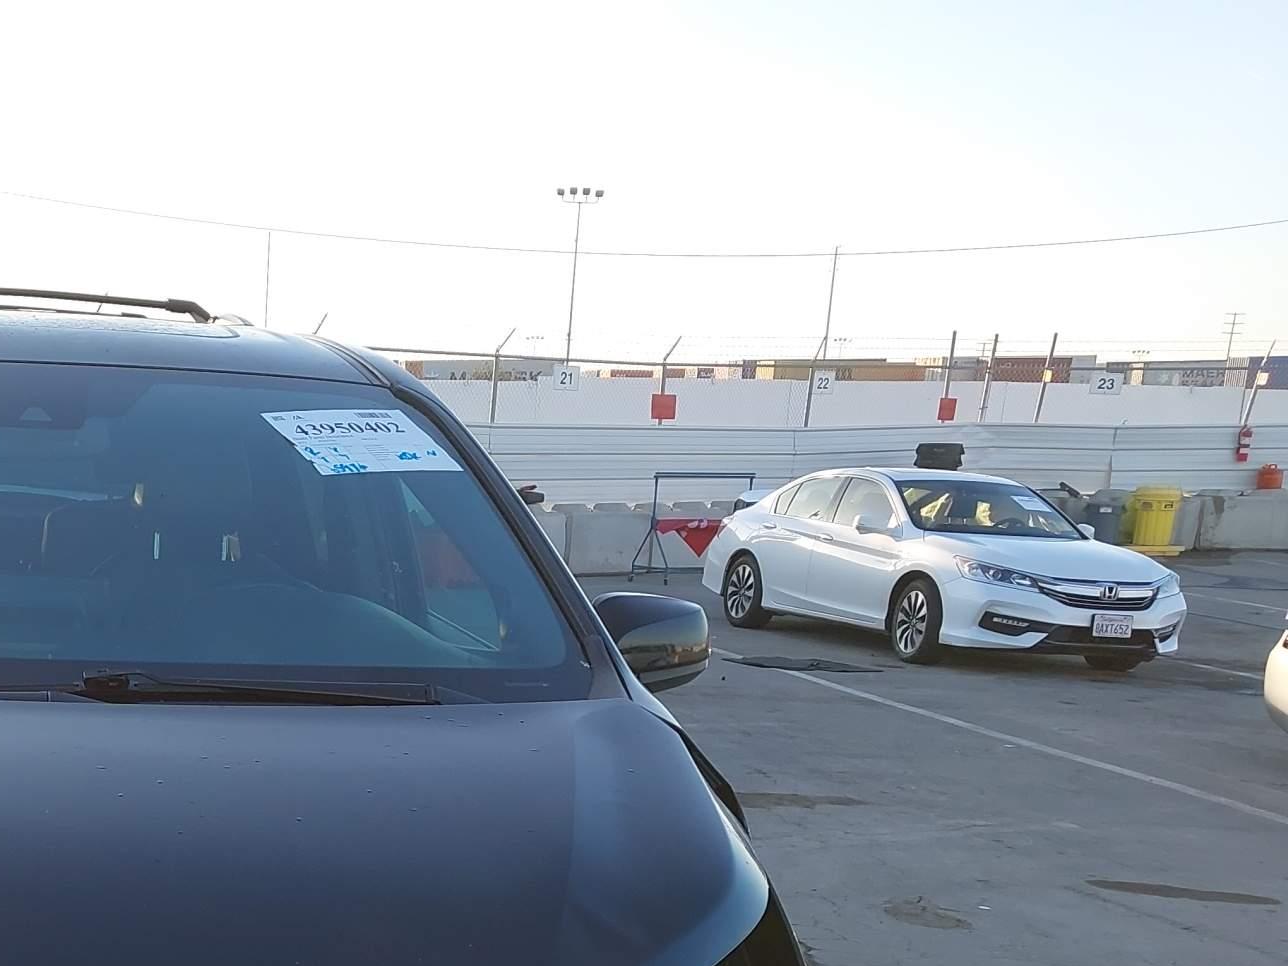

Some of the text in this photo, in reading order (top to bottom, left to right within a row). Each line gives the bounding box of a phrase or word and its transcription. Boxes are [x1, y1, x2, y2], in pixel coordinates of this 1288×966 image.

[560, 371, 573, 385] 21
[816, 377, 830, 390] 22
[1097, 378, 1115, 390] 23
[295, 421, 406, 437] 43950402
